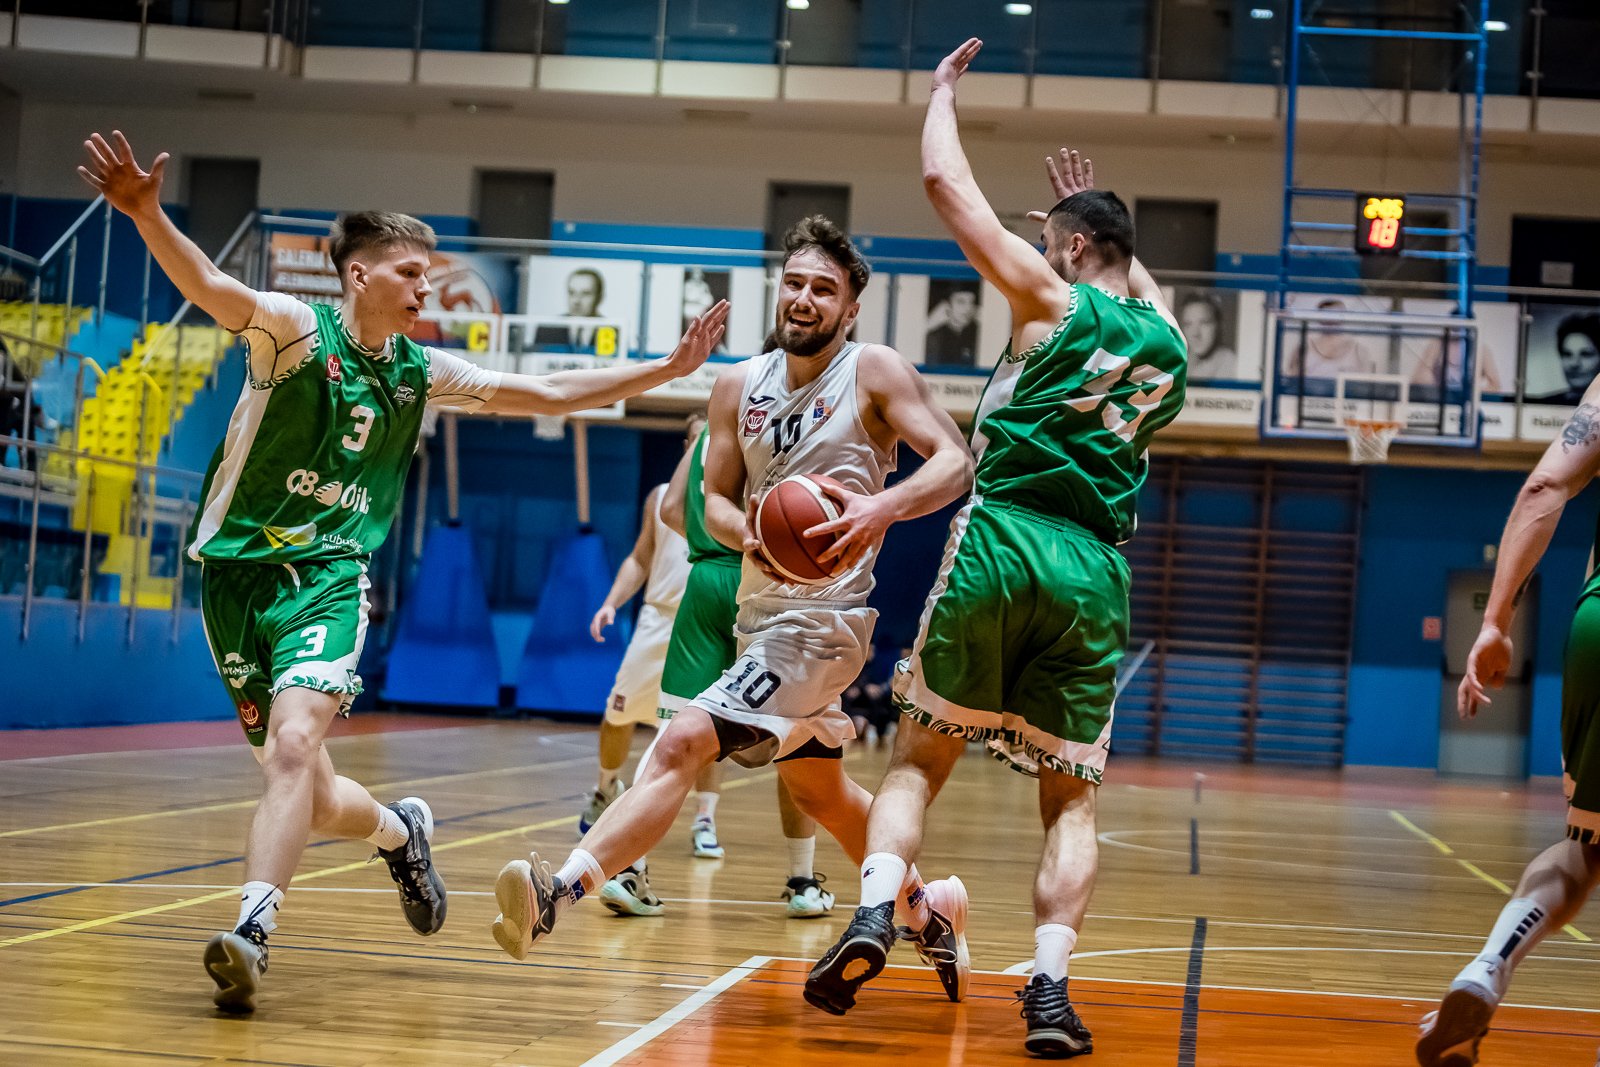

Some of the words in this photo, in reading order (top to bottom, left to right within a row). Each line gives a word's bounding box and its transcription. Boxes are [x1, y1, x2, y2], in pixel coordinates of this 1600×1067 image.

[467, 321, 489, 352] C
[596, 326, 616, 356] B
[341, 404, 376, 453] 3
[771, 413, 804, 459] 10
[295, 624, 328, 658] 3
